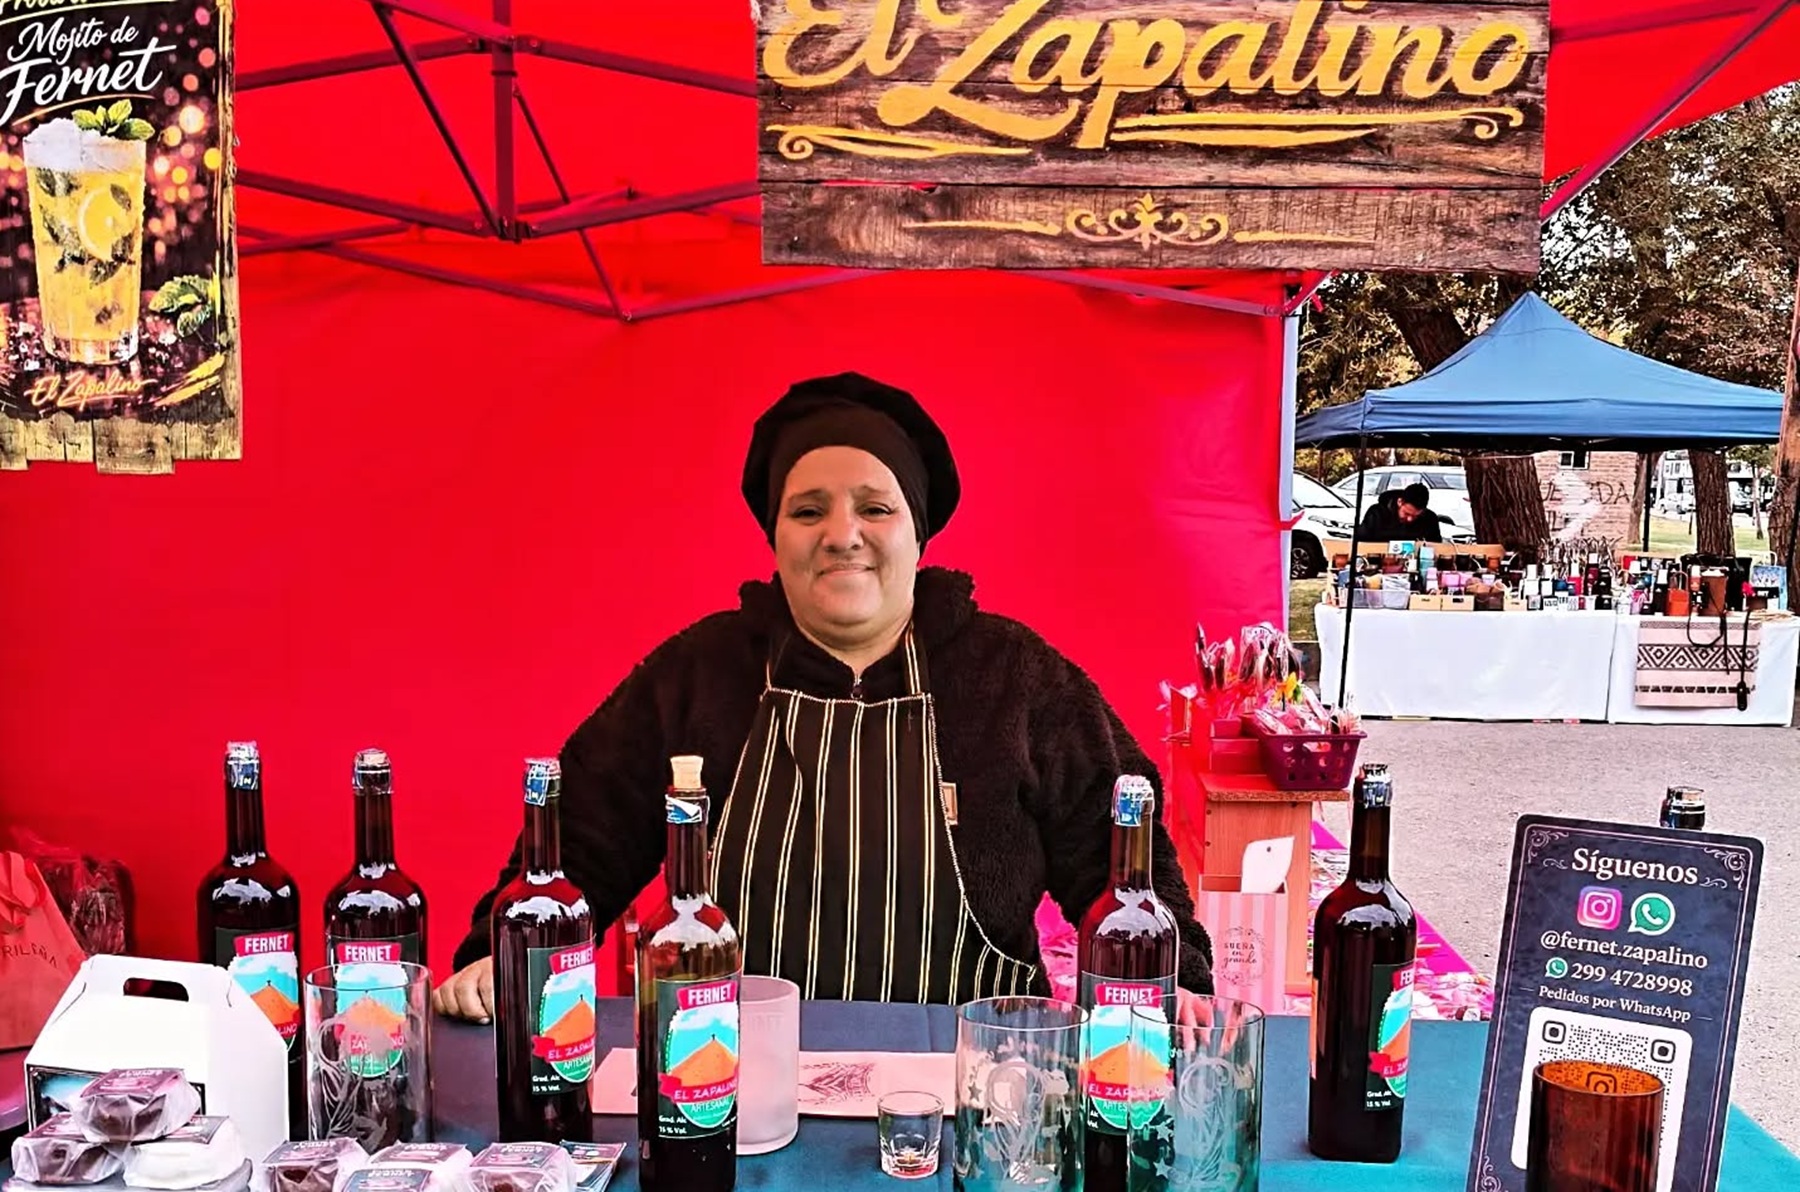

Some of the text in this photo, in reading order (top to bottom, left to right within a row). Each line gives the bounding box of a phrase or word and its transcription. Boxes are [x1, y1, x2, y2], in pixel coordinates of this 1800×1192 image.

[7, 15, 139, 65] Mojito de
[0, 37, 177, 126] Fernet
[763, 0, 1530, 149] El Zapalino
[23, 370, 158, 411] El Zapalino
[1572, 848, 1698, 885] Síguenos
[245, 934, 289, 953] FERNET
[345, 945, 392, 961] FERNET
[1540, 930, 1708, 969] @fernet.zapalino
[687, 983, 732, 1006] FERNET
[1104, 985, 1154, 1004] FERNET
[1571, 962, 1693, 997] 299 4728998
[1538, 985, 1691, 1023] Pedidos por WhatsApp
[674, 1089, 688, 1100] EL
[1088, 1083, 1101, 1093] EL
